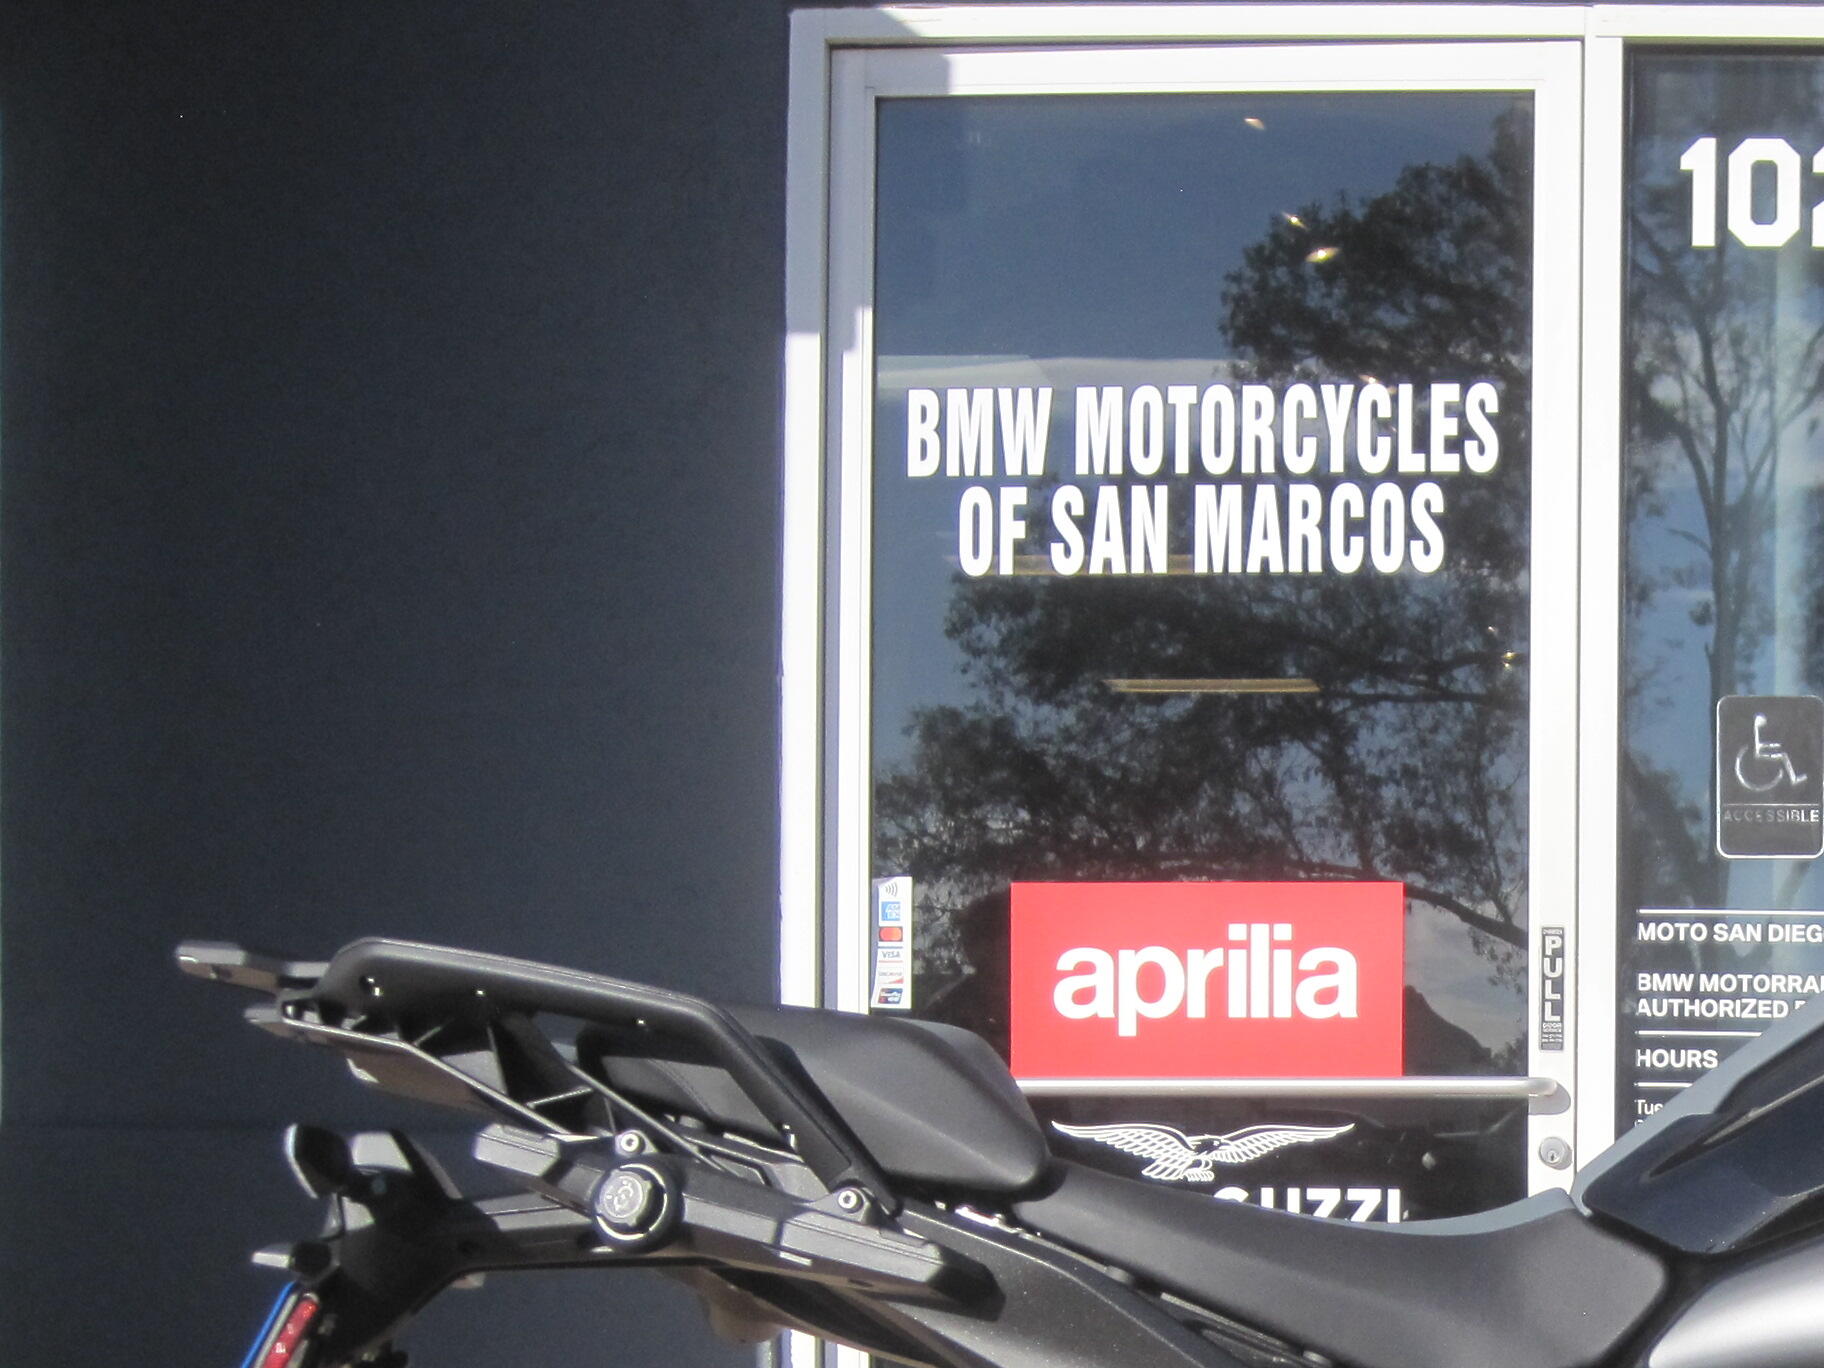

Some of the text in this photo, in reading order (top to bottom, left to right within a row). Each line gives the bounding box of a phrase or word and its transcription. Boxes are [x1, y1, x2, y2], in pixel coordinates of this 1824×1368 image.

[906, 382, 1500, 477] BMW MOTORCYCLES
[958, 482, 1445, 577] OF SAN MARCOS
[1723, 808, 1820, 824] ACCESSIBLE
[1637, 922, 1708, 941] MOTO
[1713, 923, 1762, 942] SAN
[1053, 923, 1358, 1037] aprilia
[1543, 935, 1562, 1021] PULL
[1637, 973, 1694, 991] BMW
[1636, 998, 1789, 1018] AUTHORIZED
[1636, 1049, 1719, 1068] HOURS
